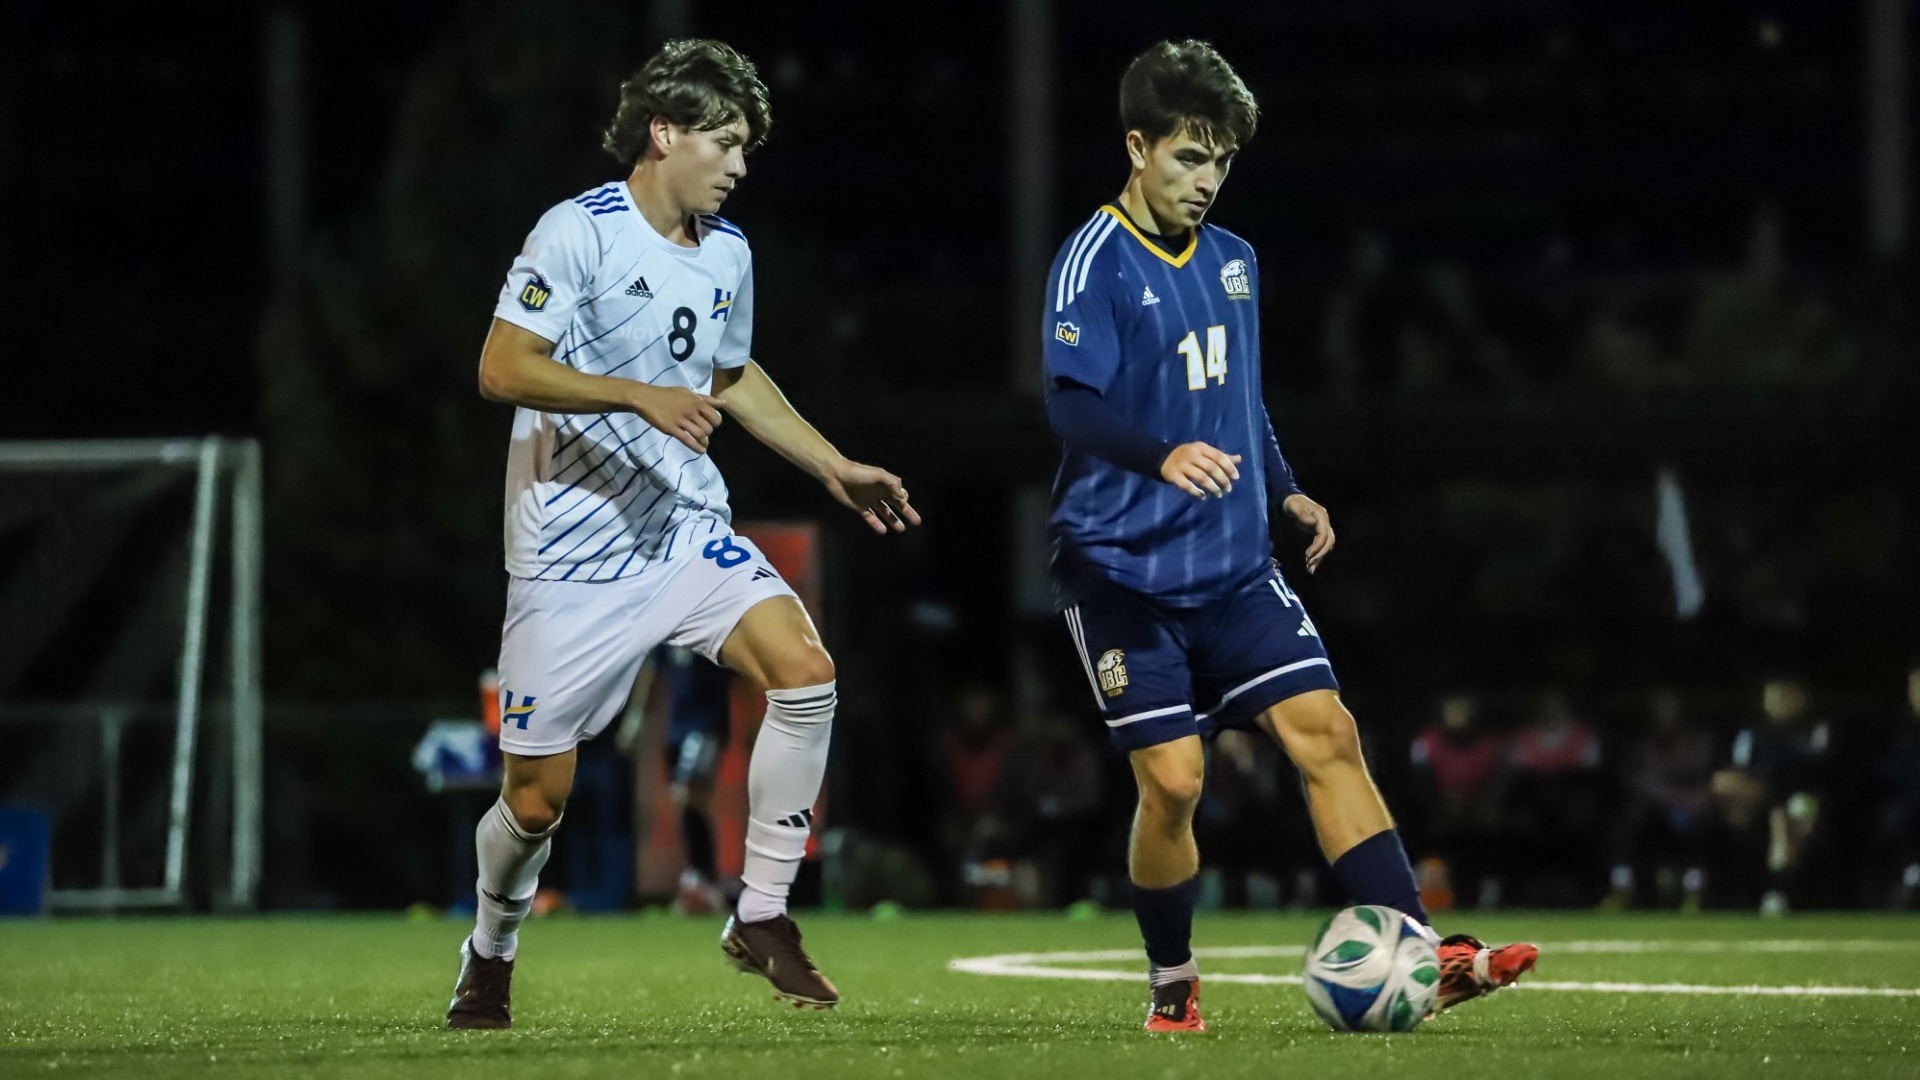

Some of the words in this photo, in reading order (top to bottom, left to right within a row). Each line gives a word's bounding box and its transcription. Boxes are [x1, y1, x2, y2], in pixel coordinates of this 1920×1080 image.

[522, 284, 548, 308] CW
[625, 289, 654, 299] adidas
[668, 306, 697, 362] 8
[1059, 327, 1076, 343] CW
[1177, 325, 1228, 390] 14
[702, 535, 751, 569] 8
